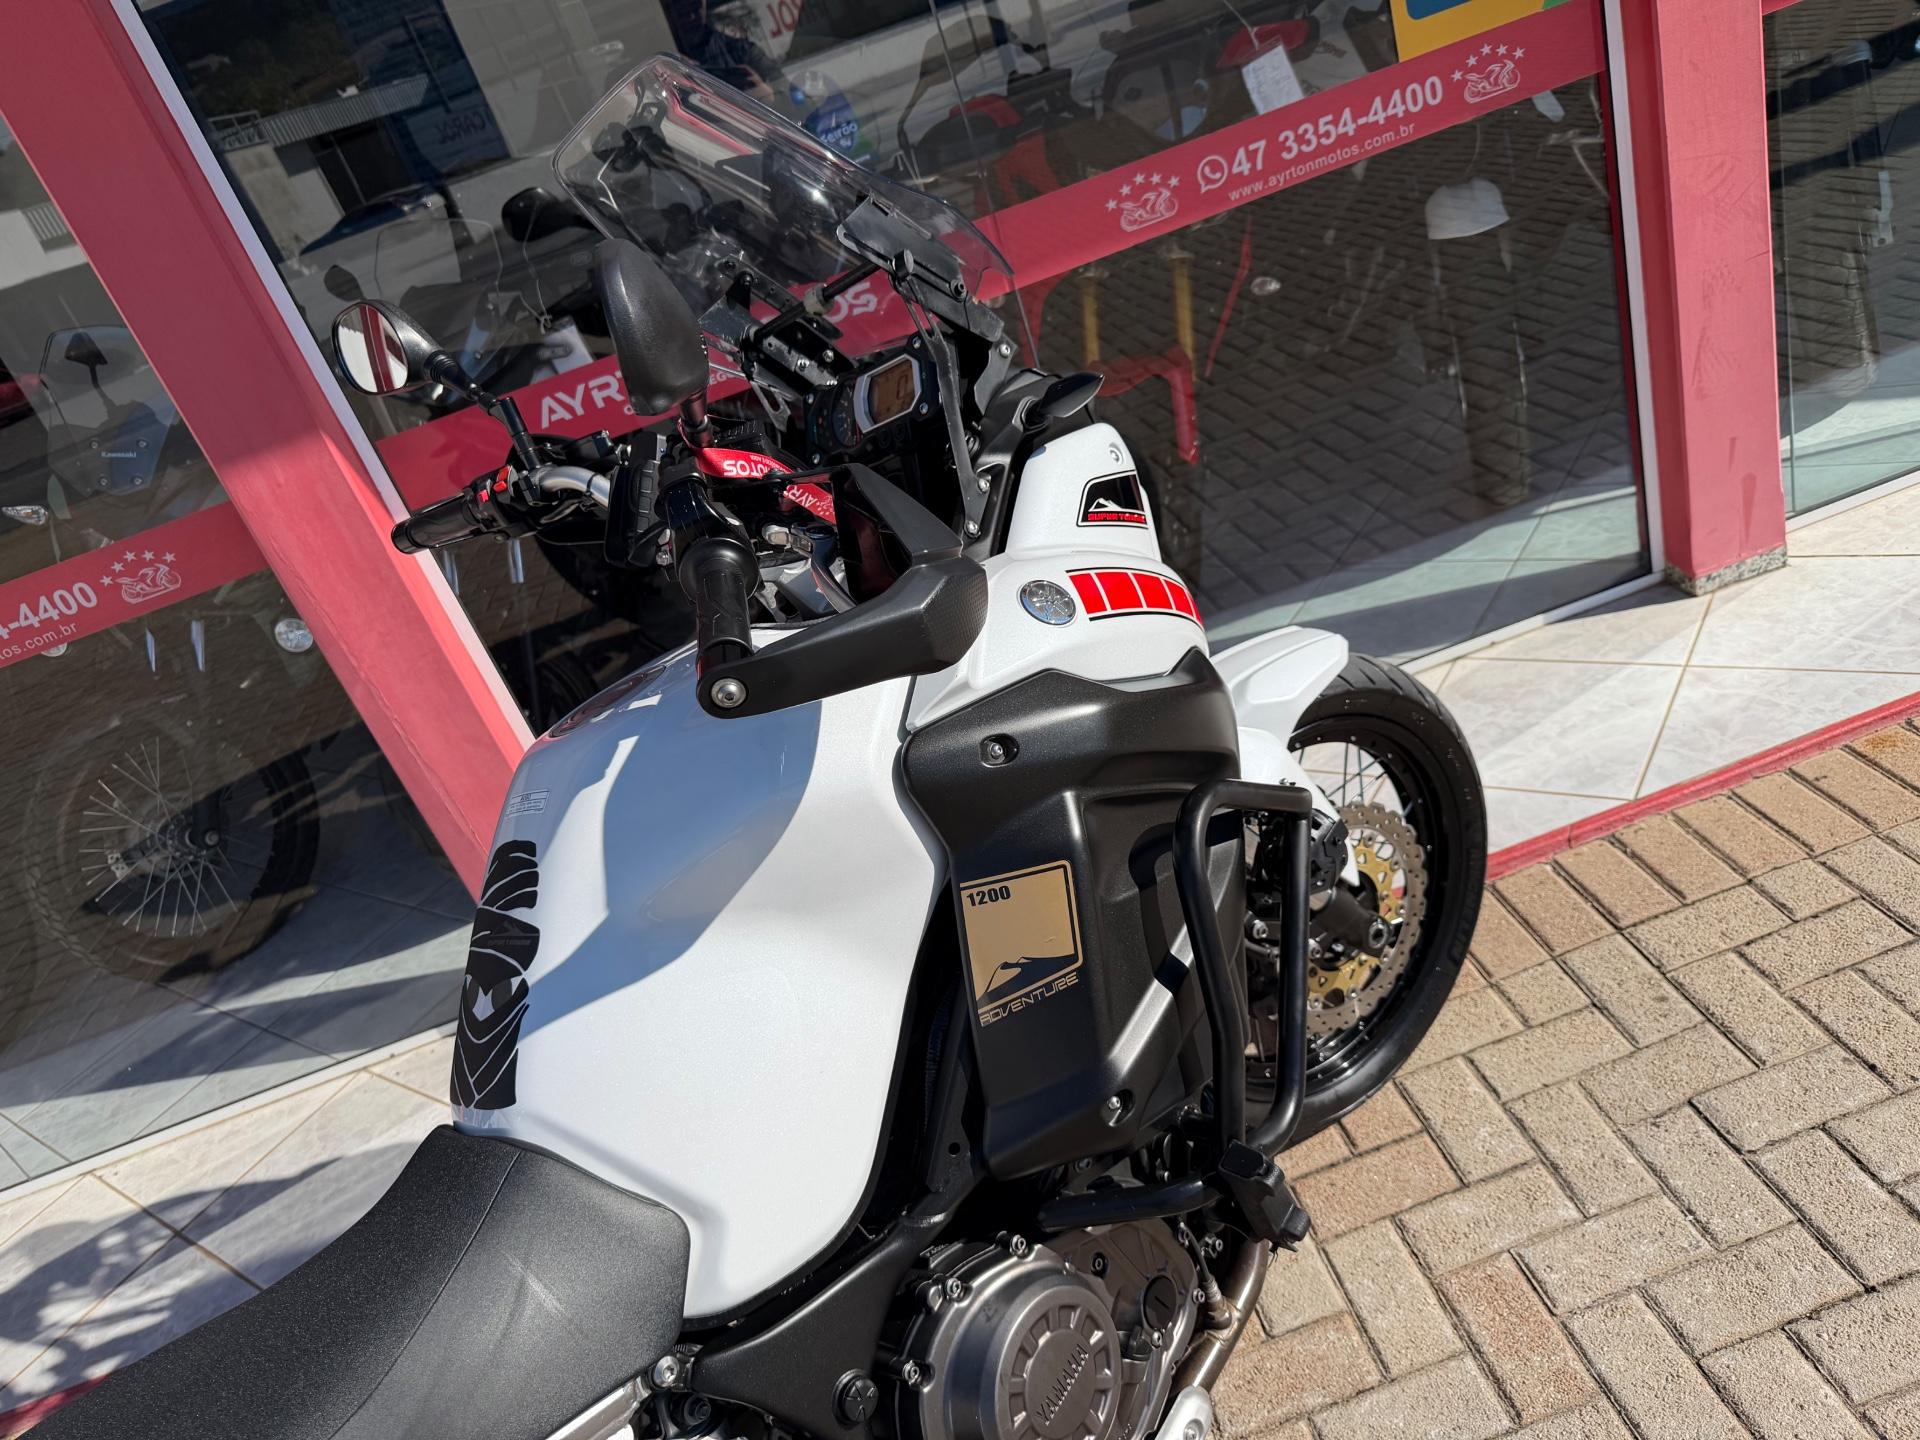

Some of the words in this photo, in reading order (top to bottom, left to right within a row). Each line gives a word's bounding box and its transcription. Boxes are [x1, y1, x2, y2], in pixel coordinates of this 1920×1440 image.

[1231, 139, 1267, 177] 47
[1278, 76, 1443, 161] 3354-4400
[1228, 123, 1415, 201] www.ayrtonmotos.com.br
[541, 370, 625, 429] AYR
[783, 485, 818, 508] AYR
[966, 885, 1012, 907] 1200
[980, 971, 1080, 1028] ADVENTURE
[1036, 1343, 1089, 1427] YAMAHA
